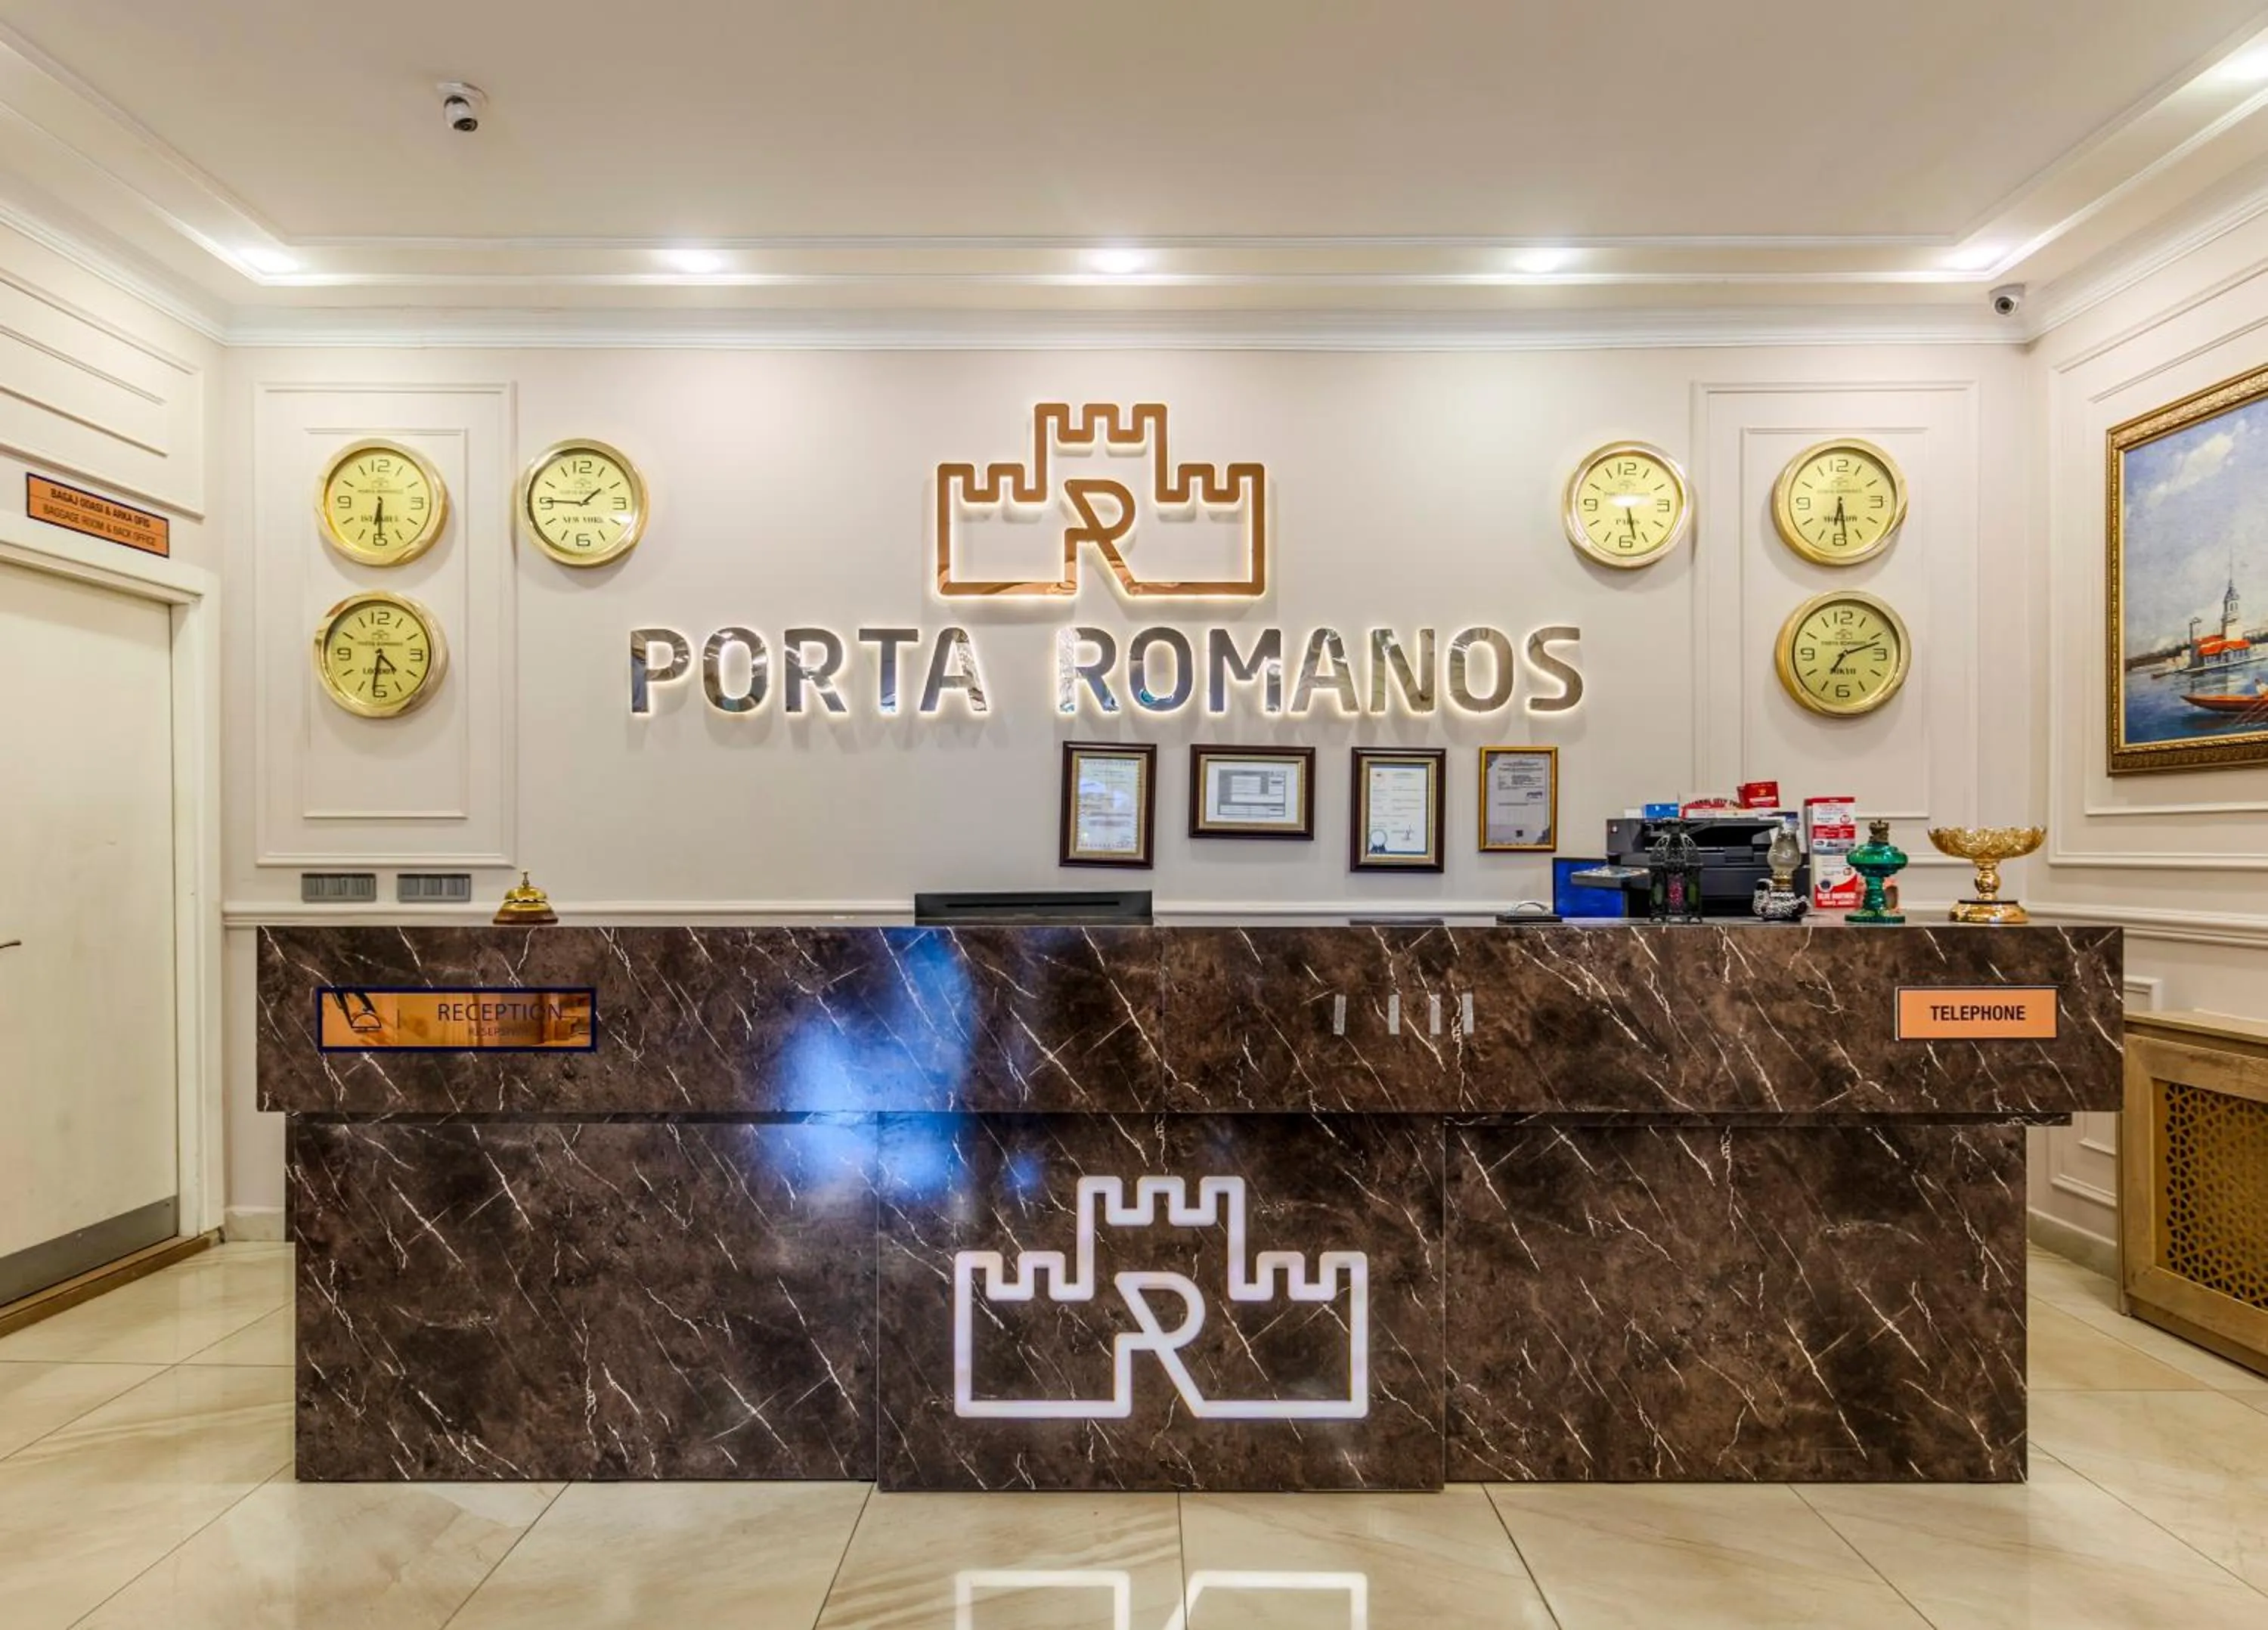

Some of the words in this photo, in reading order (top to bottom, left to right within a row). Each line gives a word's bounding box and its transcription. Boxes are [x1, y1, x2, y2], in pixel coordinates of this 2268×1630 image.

[371, 459, 390, 472] 12
[573, 460, 592, 474] 12
[1618, 462, 1637, 475] 12
[1830, 459, 1848, 472] 12
[337, 495, 352, 508] 9
[411, 497, 424, 510] 3
[539, 497, 553, 510] 9
[612, 497, 627, 510] 3
[1584, 498, 1597, 512] 9
[1657, 499, 1669, 512] 3
[1796, 497, 1811, 510] 9
[1869, 495, 1883, 508] 3
[373, 533, 388, 546] 6
[576, 533, 590, 546] 6
[1619, 535, 1633, 548] 6
[371, 612, 390, 624] 12
[1833, 611, 1853, 624] 12
[337, 648, 351, 661] 9
[410, 649, 423, 662] 3
[1800, 647, 1814, 661] 9
[1873, 648, 1887, 661] 3
[631, 628, 989, 714] PORTA
[1058, 628, 1585, 714] ROMANOS
[1836, 684, 1851, 698] 6
[438, 1003, 562, 1021] RECEPTION
[1930, 1005, 2026, 1021] TELEPHONE
